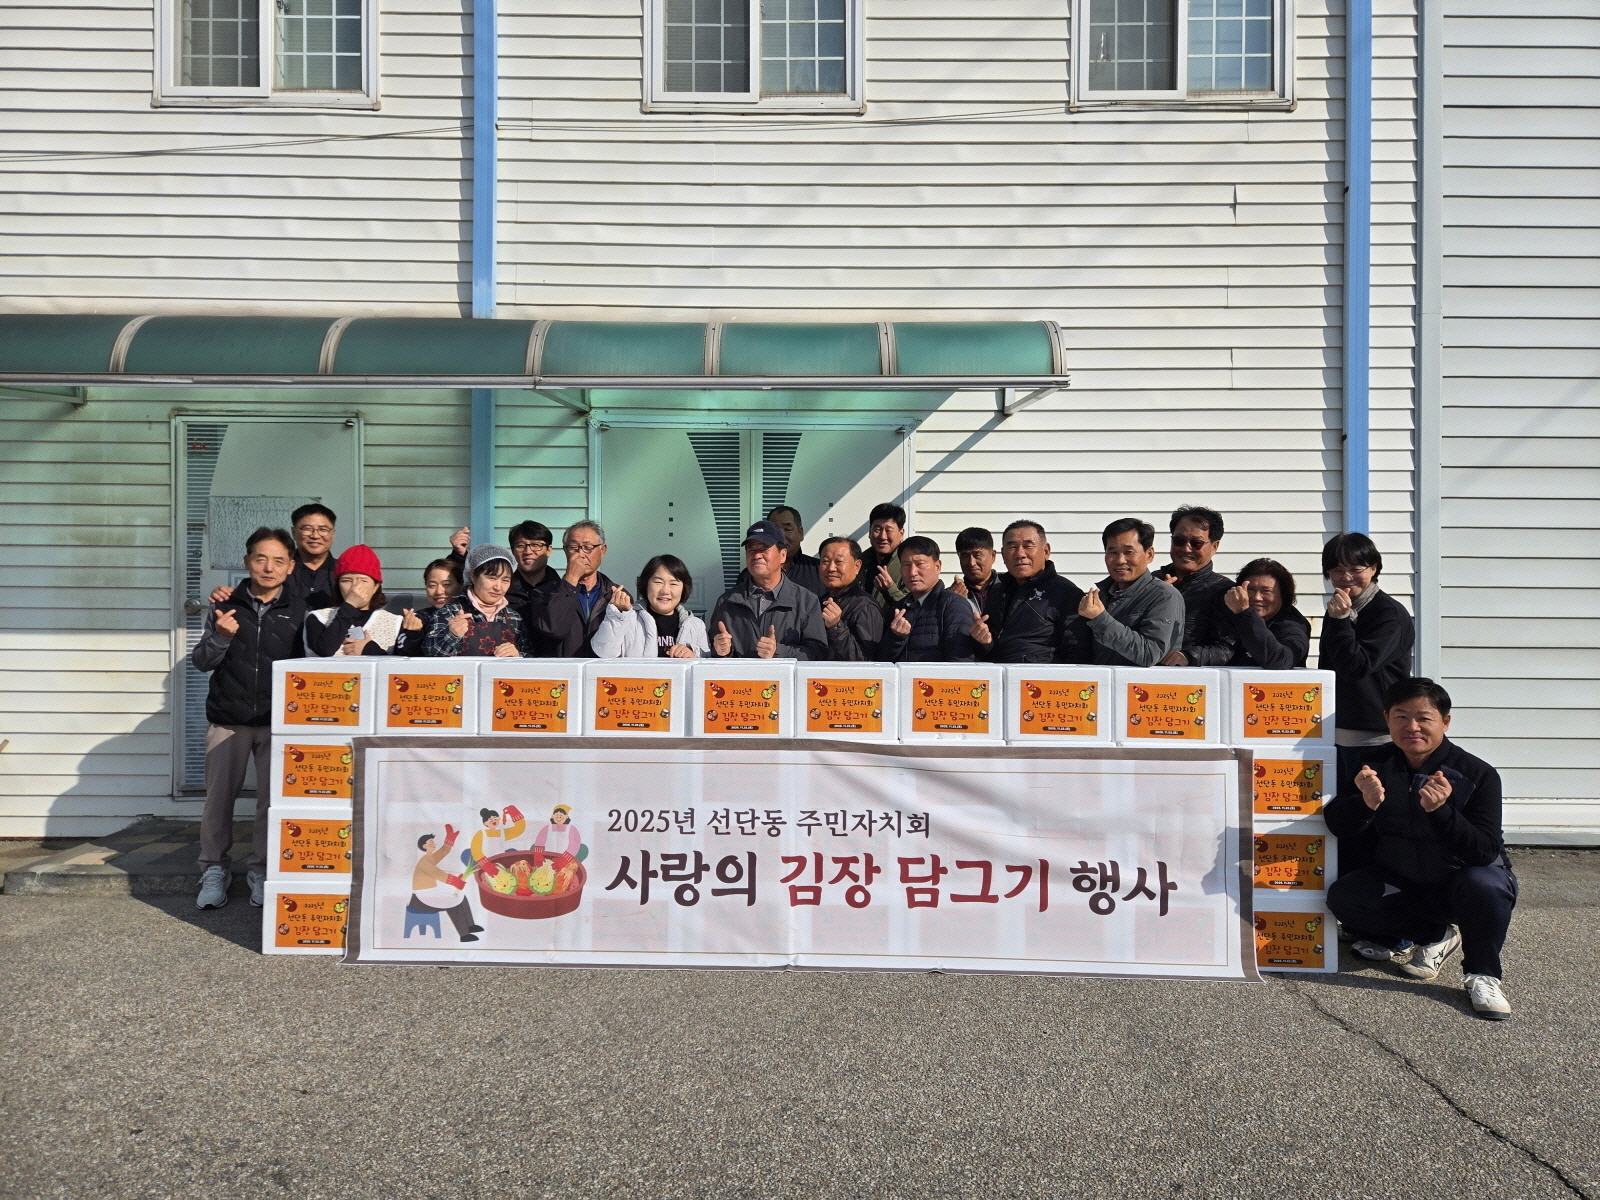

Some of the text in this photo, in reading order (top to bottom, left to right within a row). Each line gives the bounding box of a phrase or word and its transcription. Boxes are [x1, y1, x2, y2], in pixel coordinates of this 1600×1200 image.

[400, 694, 418, 702] 선단동
[303, 704, 344, 713] 김장 담그기
[739, 700, 770, 708] 주민자치회
[1139, 704, 1159, 712] 선단동
[406, 706, 448, 716] 김장 담그기
[511, 710, 552, 720] 김장 담그기
[614, 709, 655, 719] 김장 담그기
[825, 710, 867, 720] 김장 담그기
[931, 711, 974, 721] 김장 담그기
[722, 712, 764, 721] 김장 담그기
[1039, 713, 1082, 723] 김장 담그기
[1146, 716, 1190, 726] 김장 담그기
[1263, 716, 1306, 726] 김장 담그기
[301, 776, 342, 786] 김장 담그기
[607, 808, 930, 839] 2025년 선단동 주민자치회
[298, 851, 340, 861] 김장 담그기
[605, 850, 1178, 917] 사랑의 김장 담그기 행사
[294, 926, 336, 936] 김장 담그기
